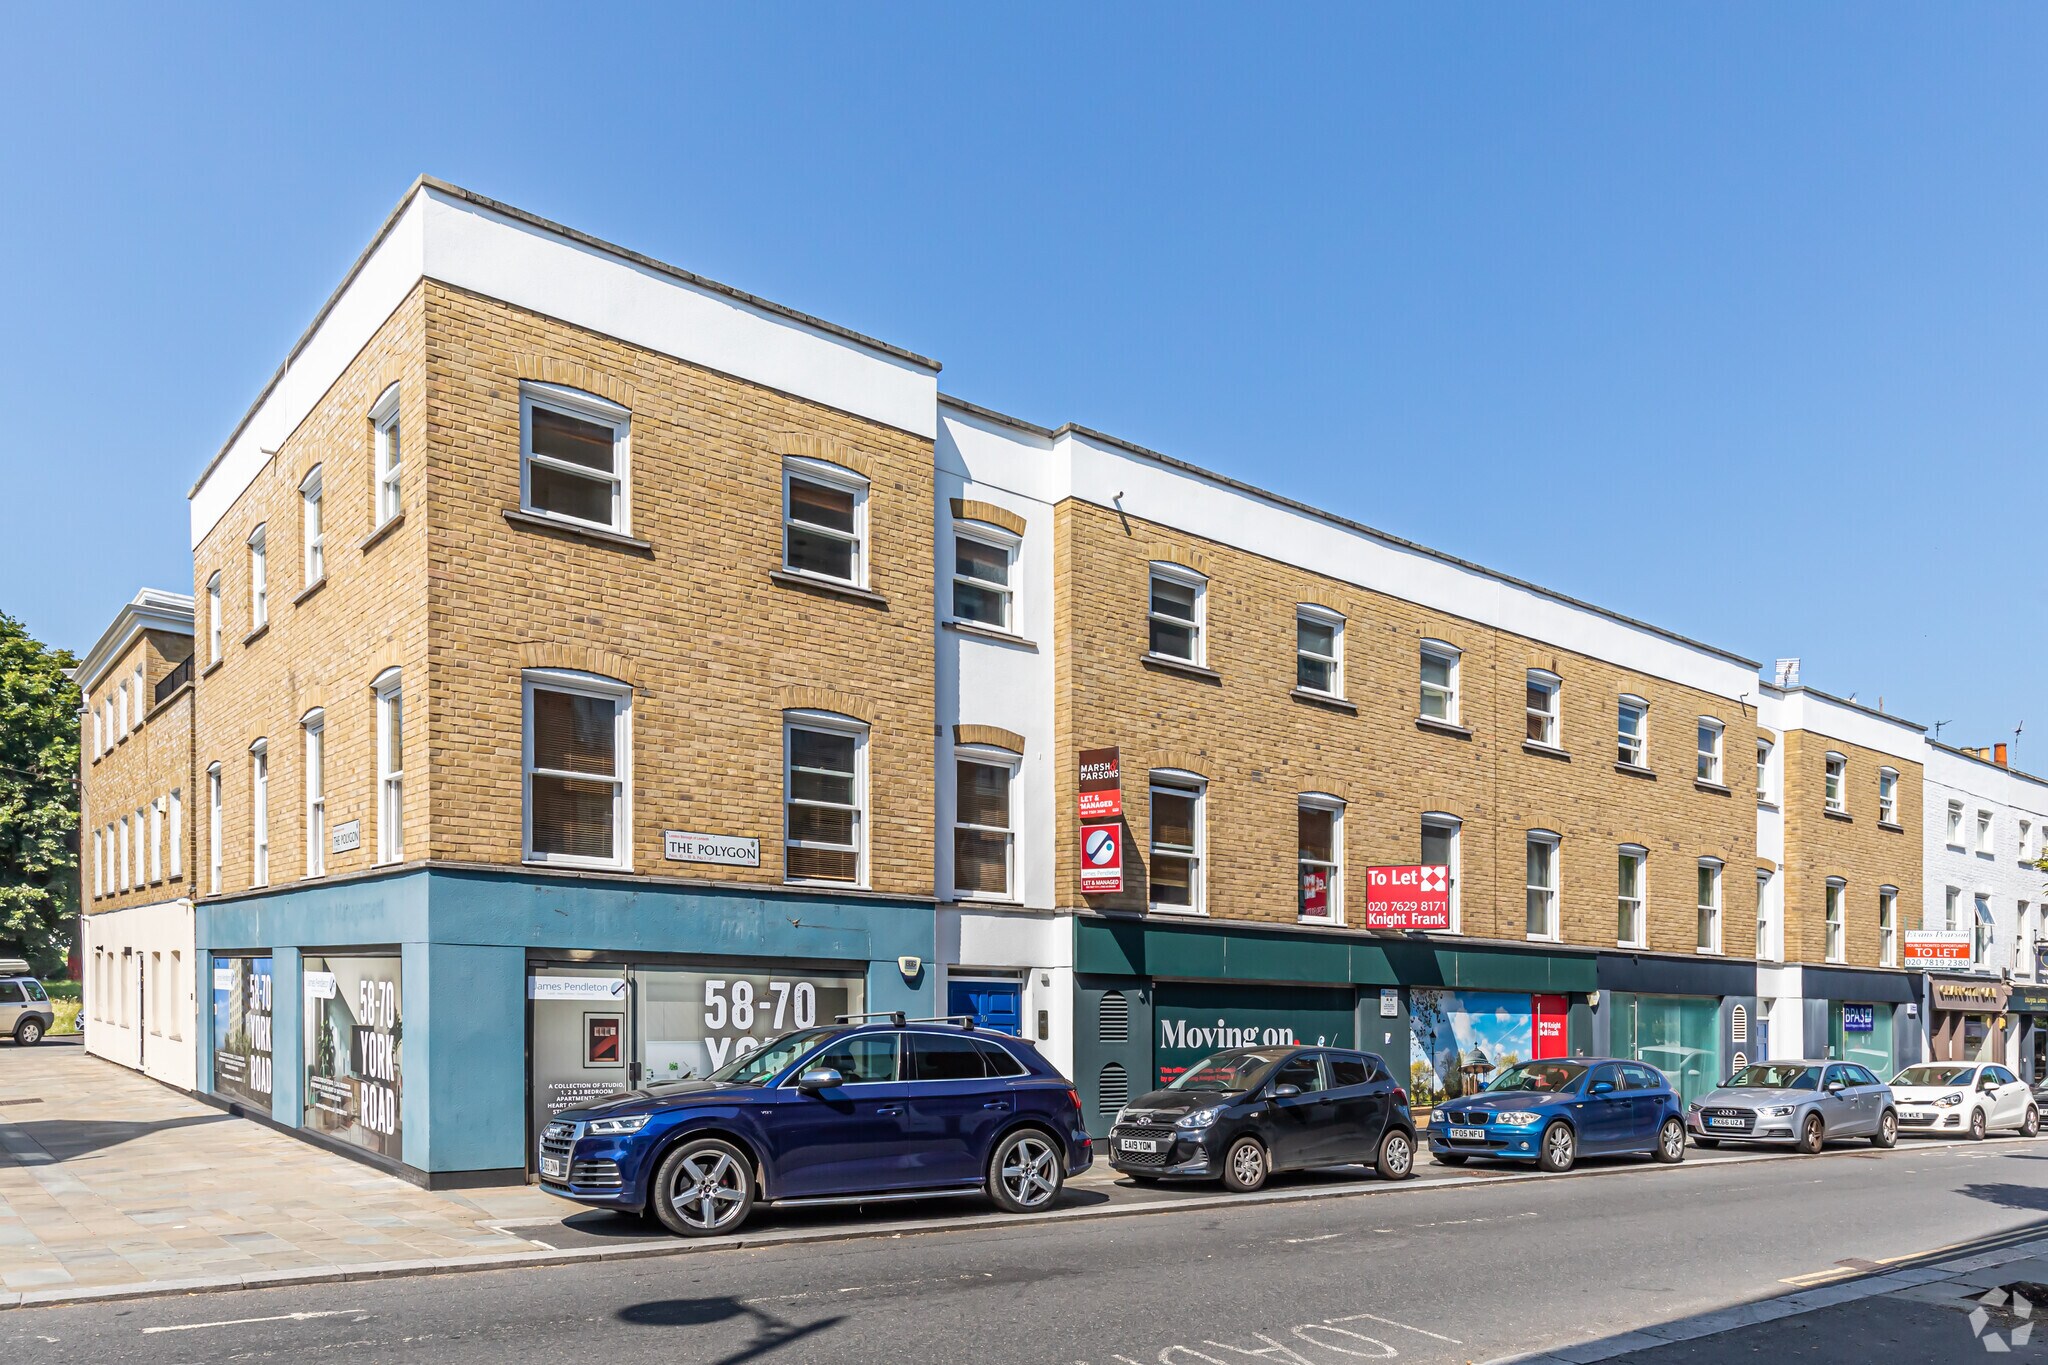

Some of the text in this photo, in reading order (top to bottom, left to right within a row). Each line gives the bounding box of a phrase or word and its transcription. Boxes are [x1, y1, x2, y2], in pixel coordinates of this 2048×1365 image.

[1081, 762, 1110, 772] MARSH
[1081, 769, 1118, 780] PARSONS
[1080, 800, 1112, 809] MANAGED
[340, 831, 358, 844] POLYGON
[669, 841, 693, 854] THE
[698, 844, 756, 859] POLYGON
[1368, 870, 1418, 885] To Let
[1368, 901, 1446, 911] 020 7629 8171
[1368, 913, 1446, 927] Knight Frank
[1915, 948, 1959, 957] TO LET
[250, 974, 271, 1011] 58-70
[533, 982, 608, 992] James Pendleton
[360, 980, 395, 1029] 58-70
[704, 980, 816, 1029] 58-70
[981, 1014, 988, 1022] 10
[1845, 1007, 1864, 1022] BPAS
[1160, 1018, 1260, 1048] Moving
[1547, 1022, 1561, 1030] Knight
[251, 1015, 271, 1052] YORK
[360, 1031, 395, 1082] YORK
[251, 1055, 271, 1094] ROAD
[361, 1083, 395, 1135] ROAD
[1451, 1129, 1483, 1138] YF05 NFU
[1124, 1140, 1138, 1150] EA19
